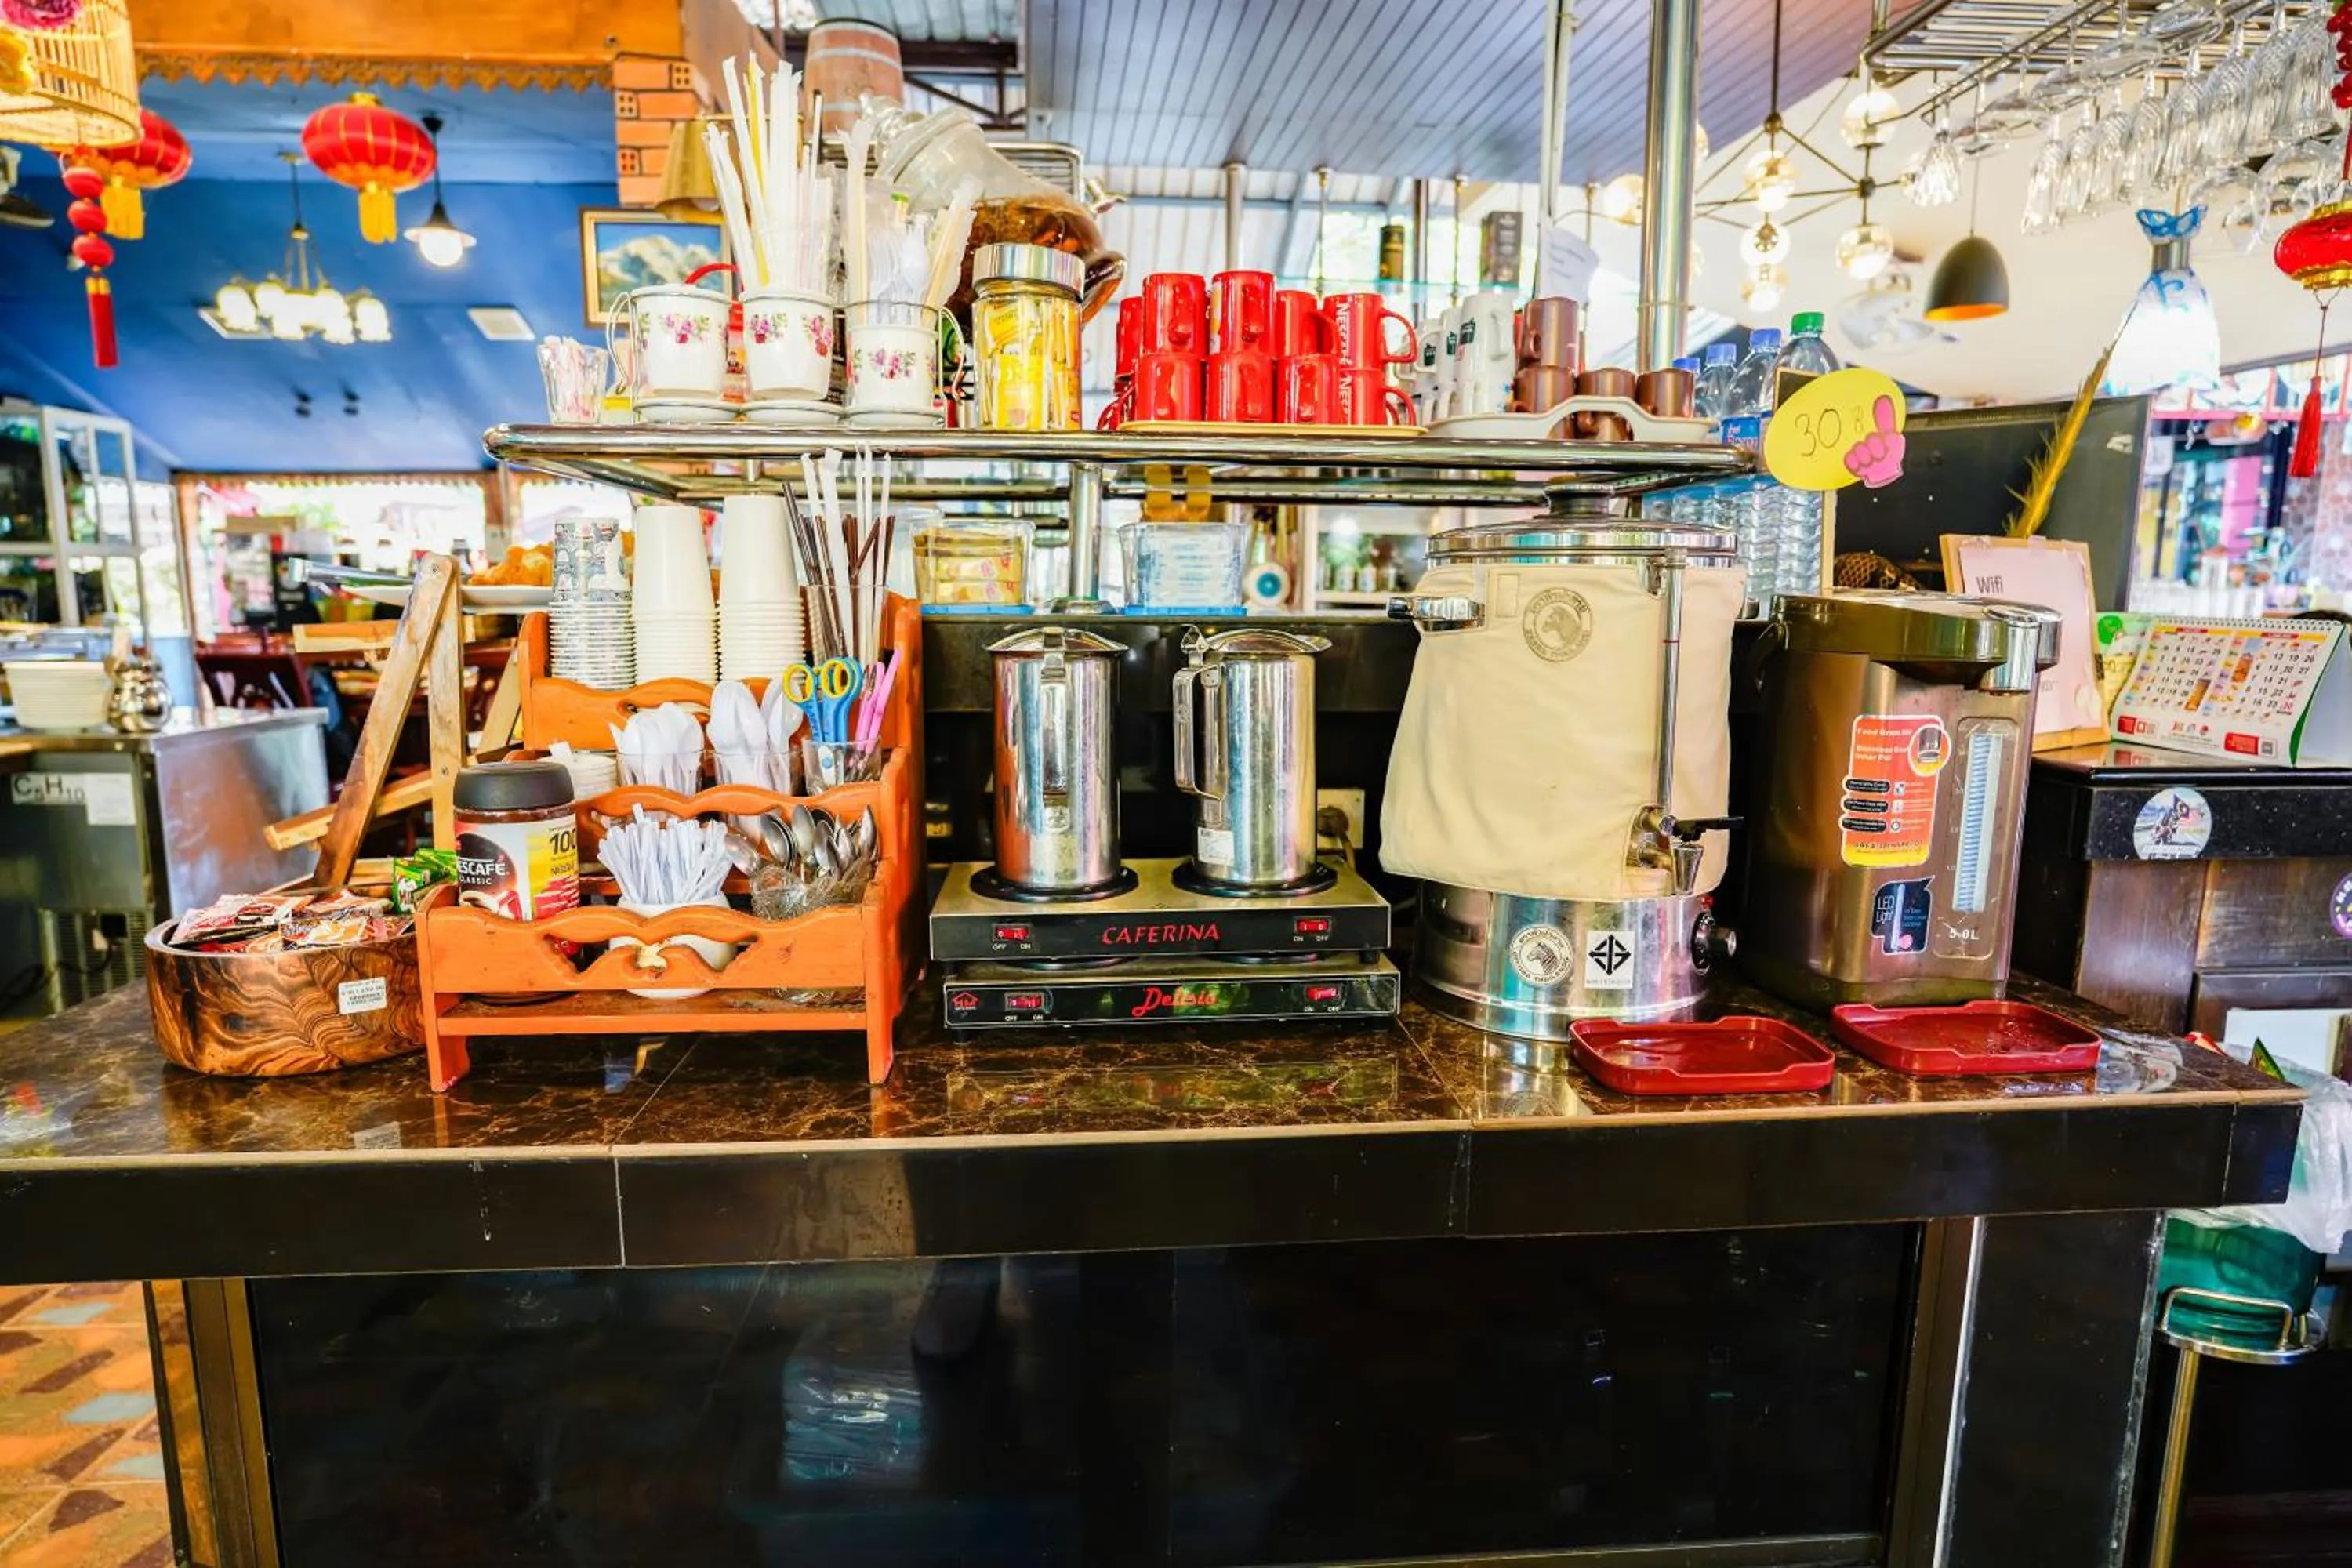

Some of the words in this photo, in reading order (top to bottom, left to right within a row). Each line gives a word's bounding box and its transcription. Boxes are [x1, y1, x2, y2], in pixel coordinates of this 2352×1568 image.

[1795, 408, 1842, 457] 30
[1975, 575, 2004, 593] Wifi
[1102, 924, 1220, 946] CAFERINA
[1131, 986, 1218, 1018] Delisio
